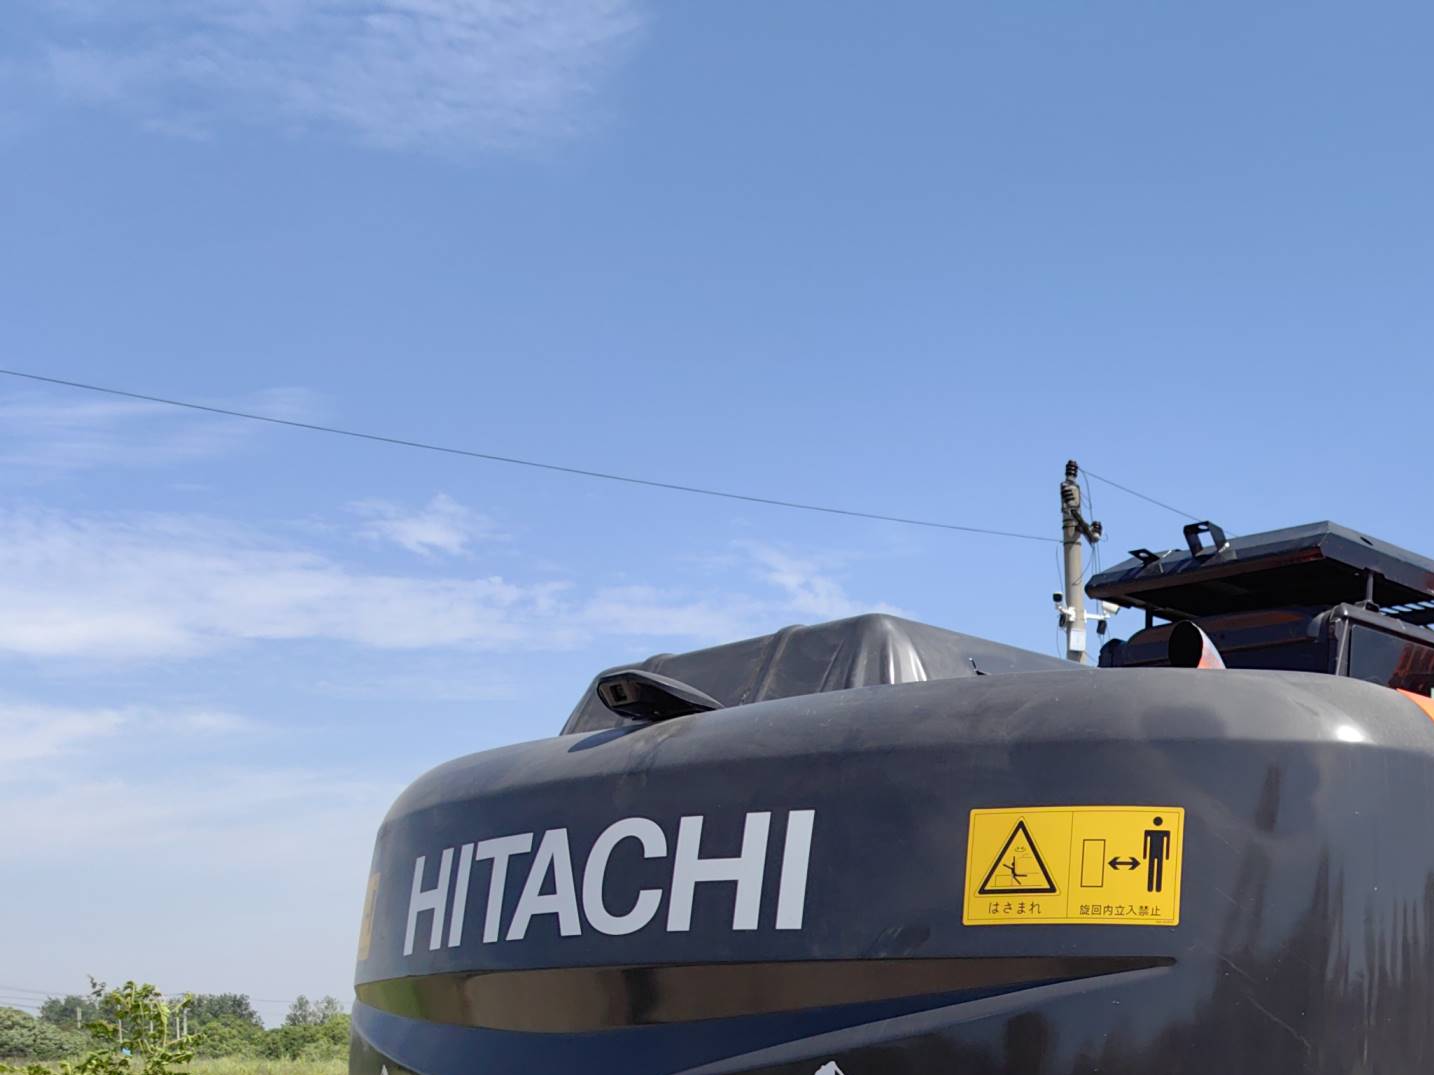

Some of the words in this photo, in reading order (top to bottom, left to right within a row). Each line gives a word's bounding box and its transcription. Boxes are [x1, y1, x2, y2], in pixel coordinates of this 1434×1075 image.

[403, 809, 815, 956] HITACHI
[988, 901, 1041, 915] はさまれ
[1079, 904, 1161, 917] 旋回内立入禁止
